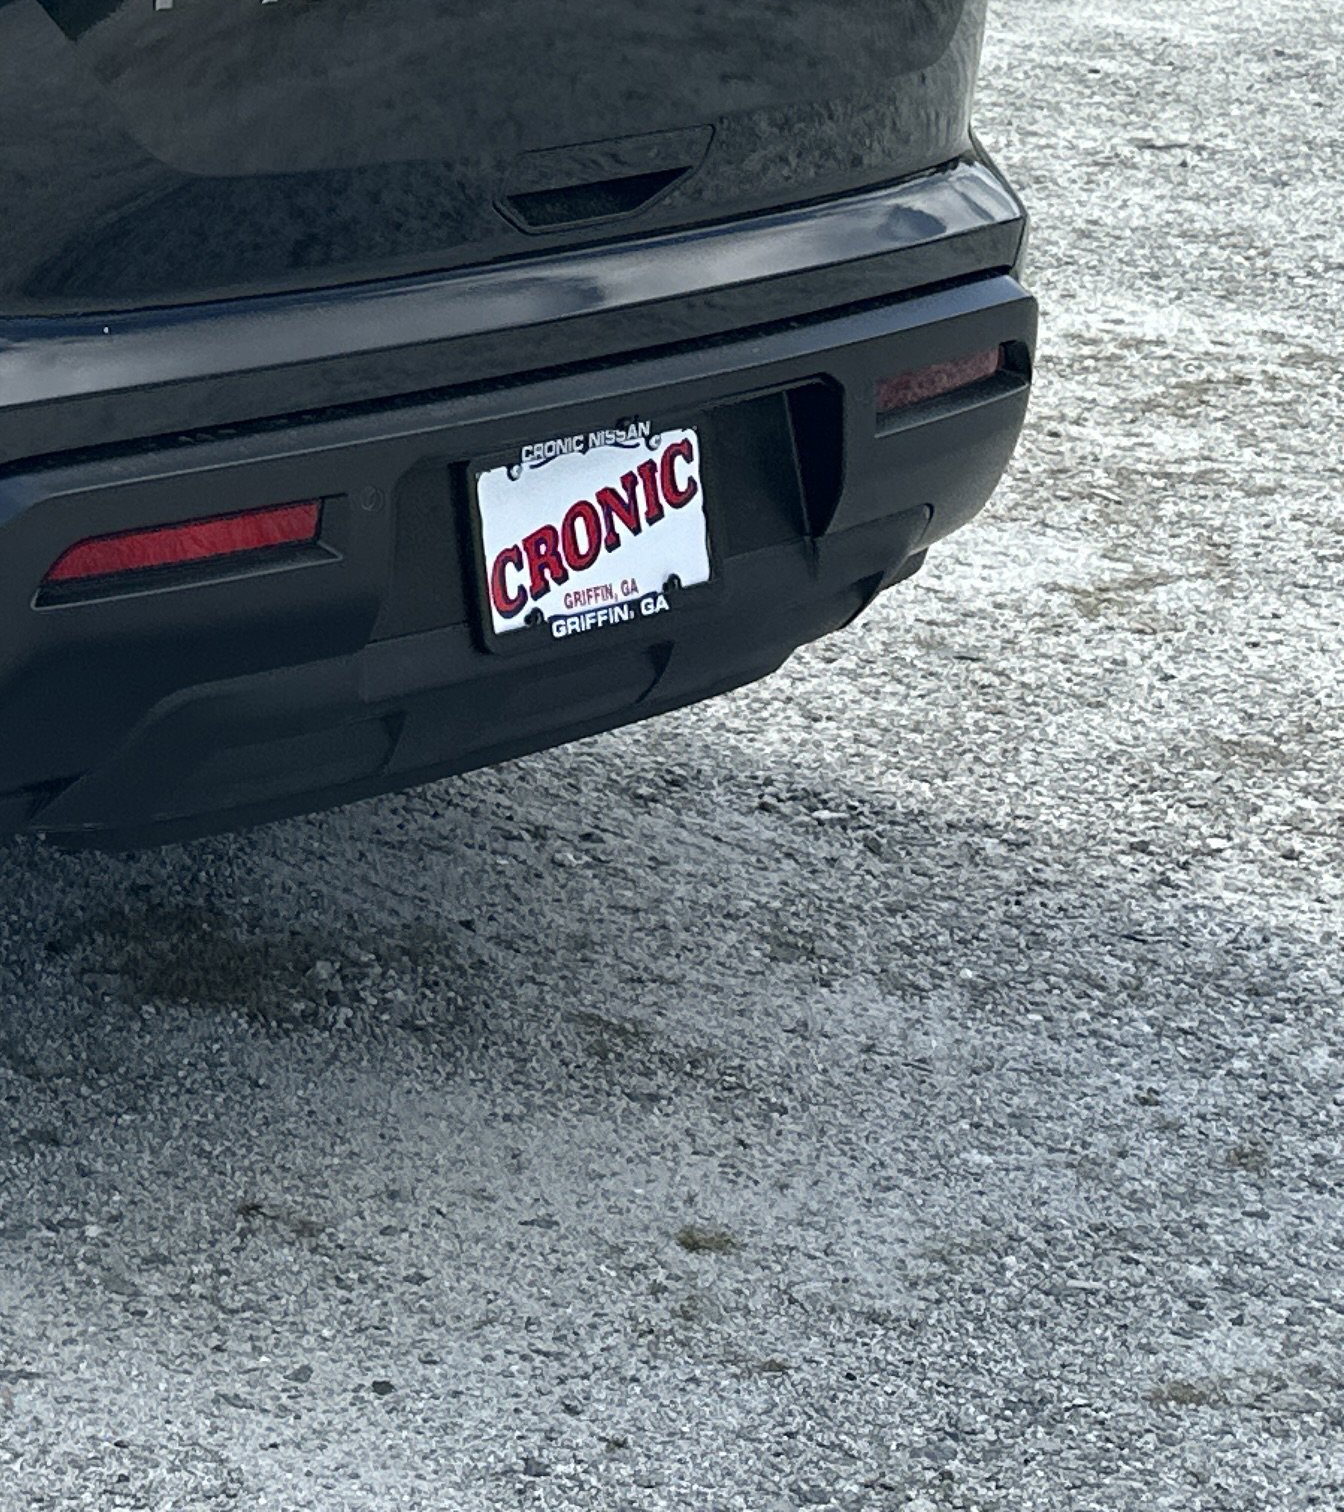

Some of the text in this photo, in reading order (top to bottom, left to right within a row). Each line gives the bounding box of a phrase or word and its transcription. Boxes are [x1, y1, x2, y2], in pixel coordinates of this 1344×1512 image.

[520, 419, 652, 464] CRONIC NISSAN
[490, 437, 699, 620] CRONIC
[552, 594, 670, 639] GRIFFIN, GA
[563, 578, 640, 610] GRIFFIN, GA
